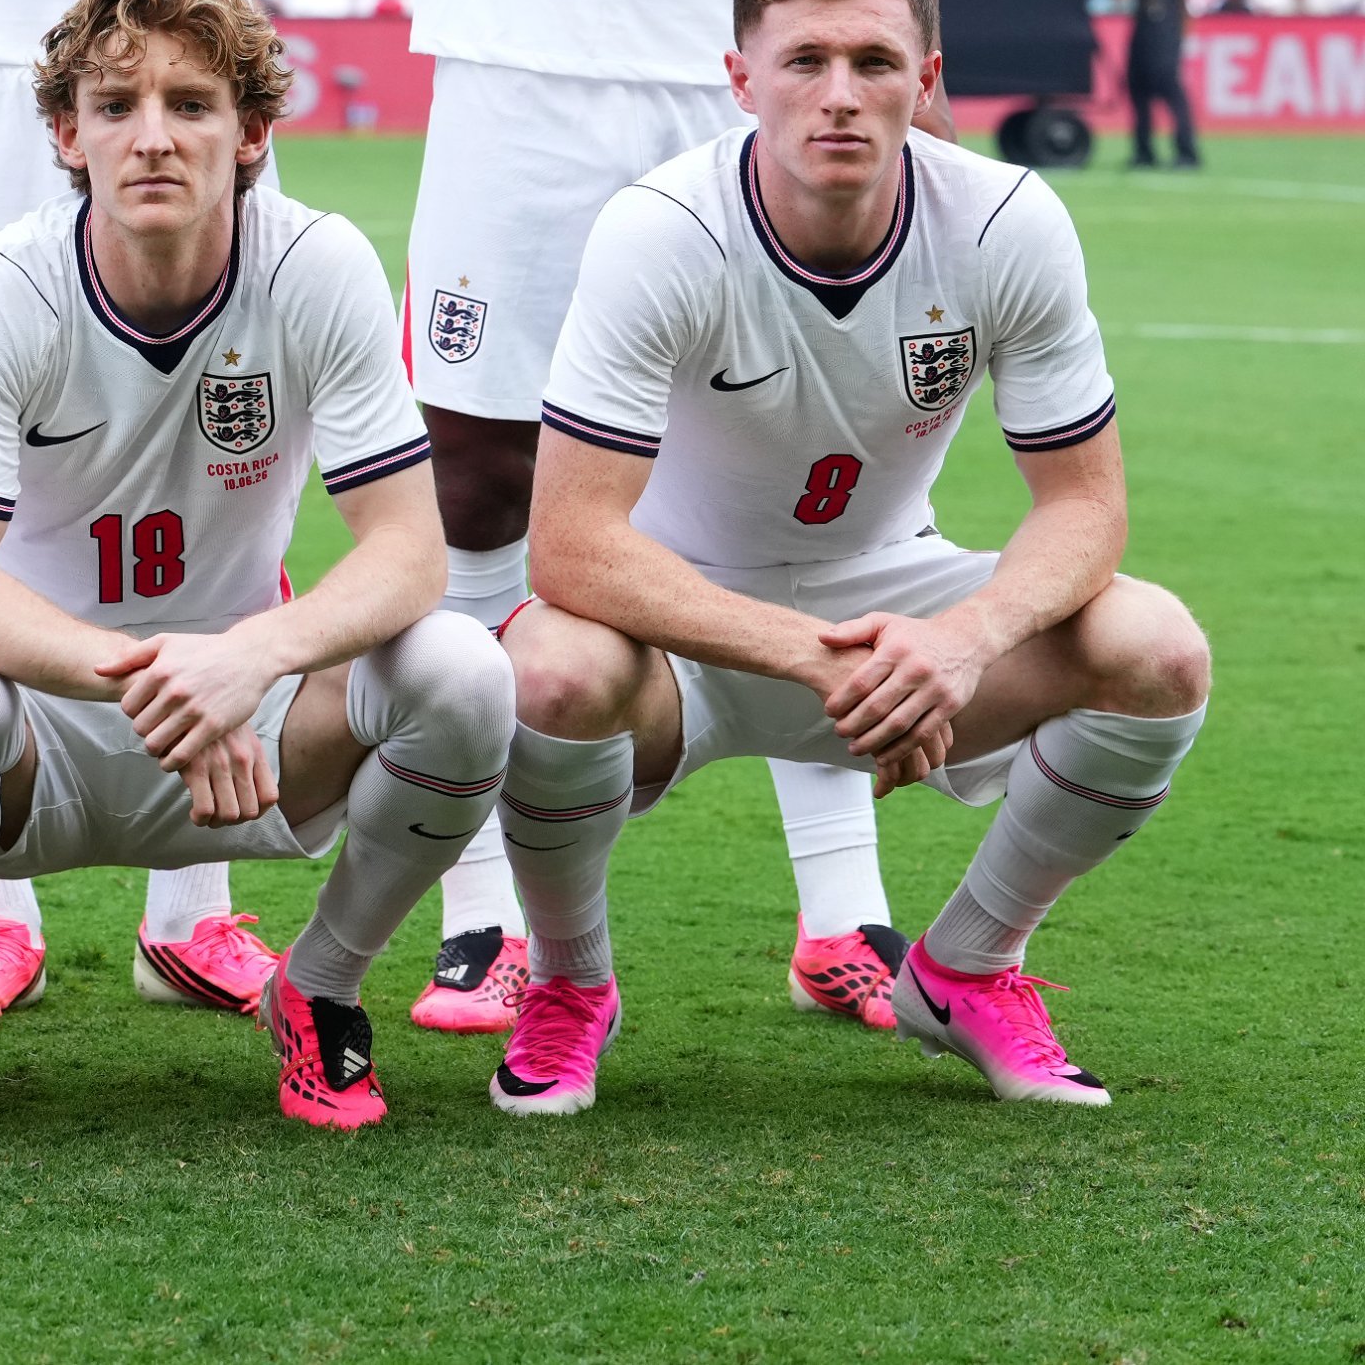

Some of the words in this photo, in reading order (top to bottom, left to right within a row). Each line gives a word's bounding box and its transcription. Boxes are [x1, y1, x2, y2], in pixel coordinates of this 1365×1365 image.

[1180, 34, 1365, 117] EAM
[905, 414, 941, 434] COSTA
[207, 461, 249, 477] COSTA
[252, 452, 279, 472] RICA
[223, 470, 268, 491] 10.06.26
[793, 453, 863, 526] 8
[89, 509, 186, 605] 18
